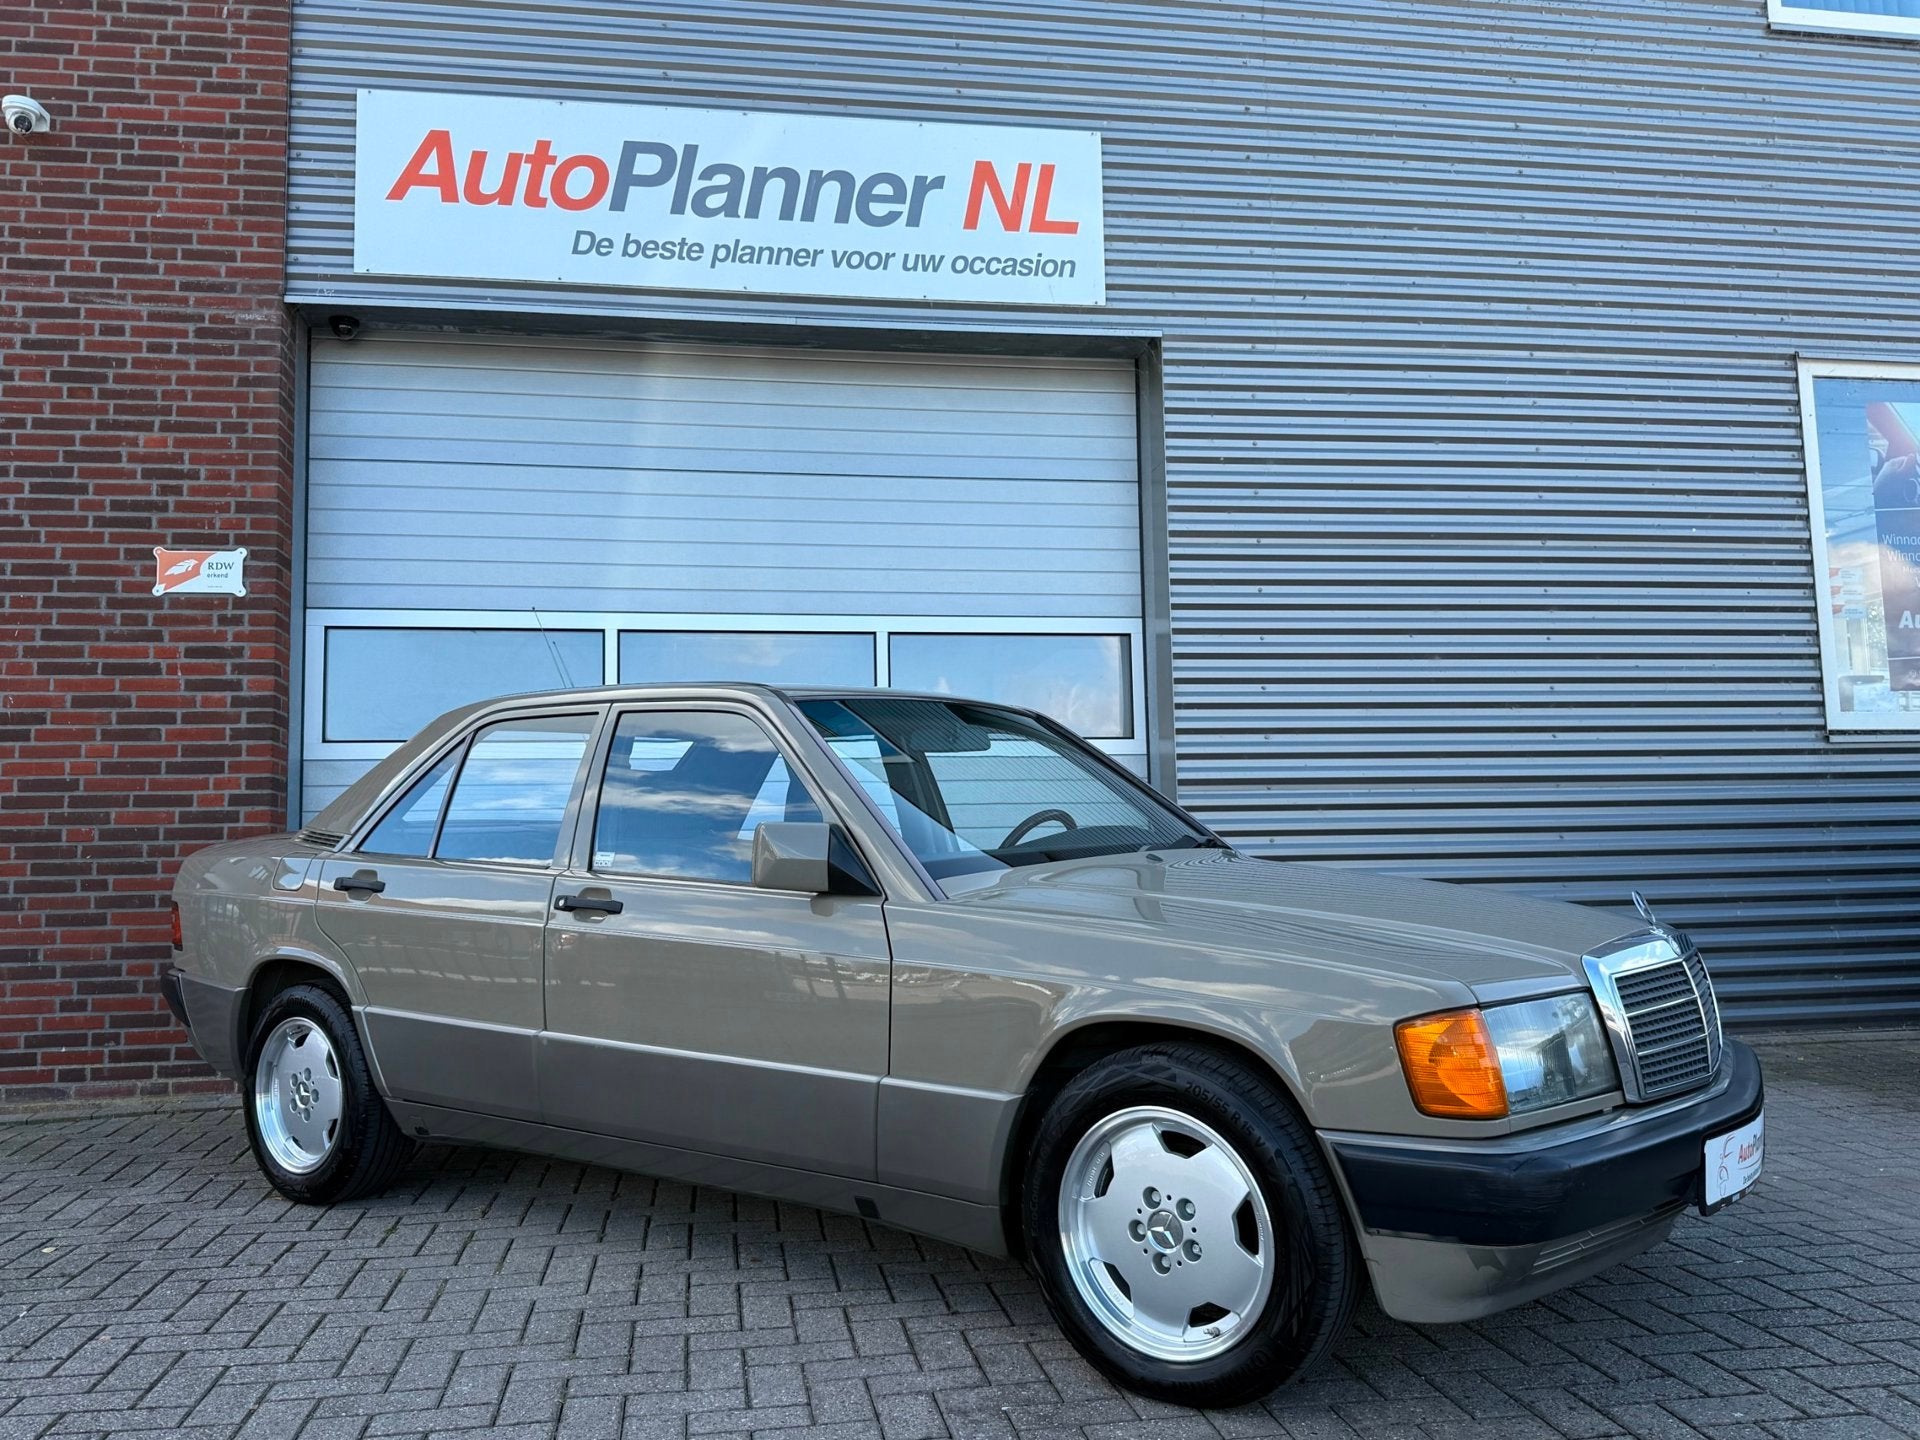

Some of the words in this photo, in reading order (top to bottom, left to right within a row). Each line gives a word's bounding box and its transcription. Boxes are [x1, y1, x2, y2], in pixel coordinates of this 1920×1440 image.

[386, 129, 945, 228] AutoPlanner
[962, 160, 1079, 235] NL
[572, 230, 613, 257] De
[622, 233, 704, 262] beste
[711, 239, 824, 269] planner
[831, 250, 896, 271] voor
[902, 254, 945, 273] uw
[951, 253, 1076, 278] occasion
[207, 562, 234, 570] RDW
[1184, 1081, 1230, 1114] 205/55
[1230, 1111, 1241, 1124] R
